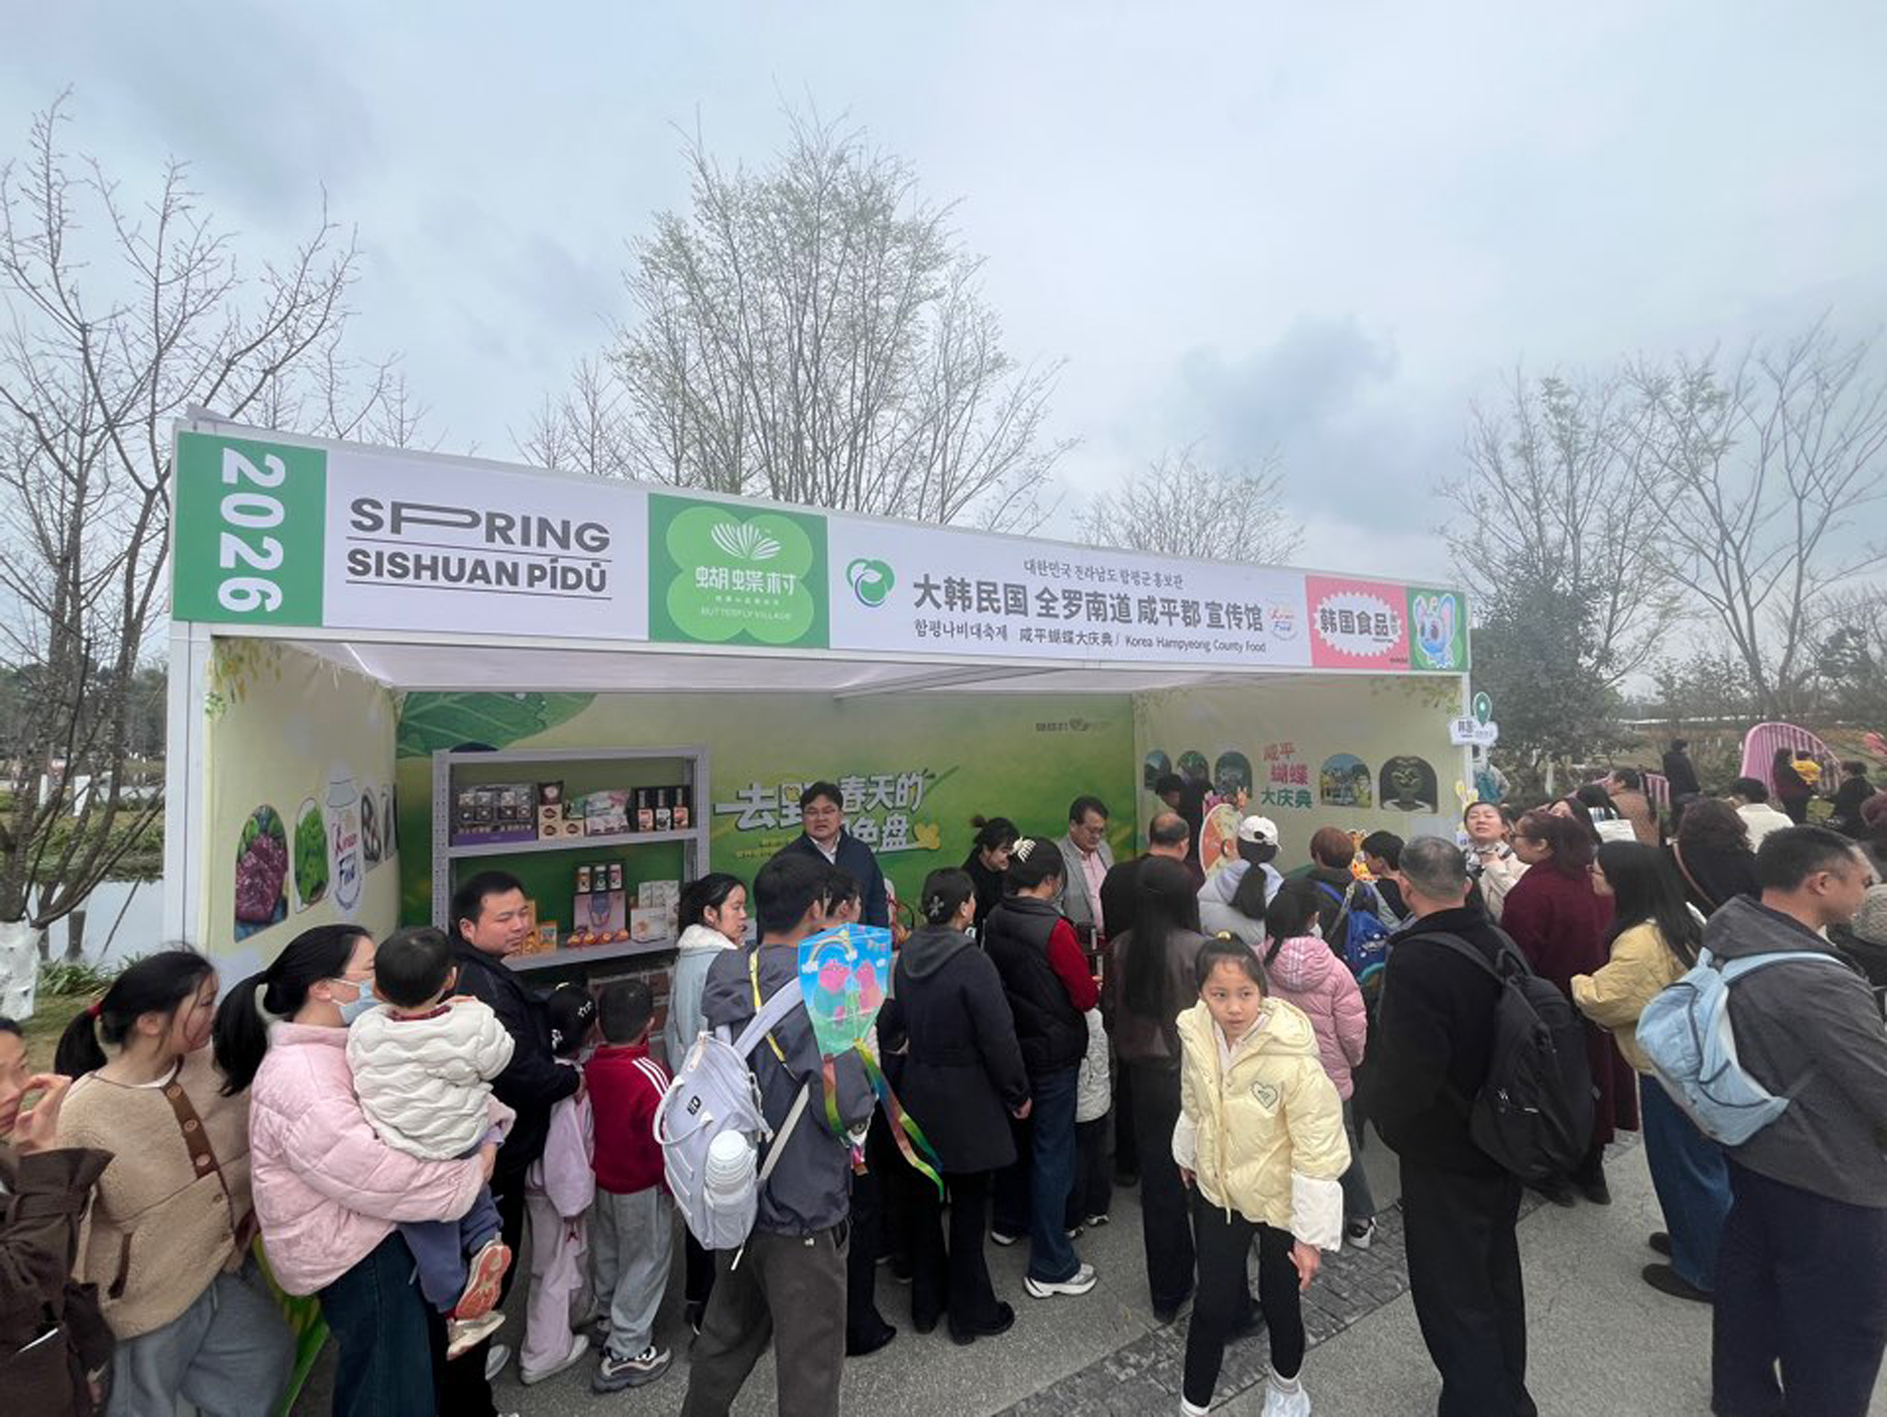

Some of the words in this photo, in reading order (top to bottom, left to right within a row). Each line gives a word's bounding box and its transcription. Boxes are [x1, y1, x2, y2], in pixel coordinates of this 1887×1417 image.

[218, 447, 286, 612] 2026
[350, 498, 610, 553] SPRING
[347, 548, 519, 587] SISHUAN
[695, 565, 797, 597] 蝴蝶村
[1024, 559, 1072, 579] 대한민국
[1074, 565, 1118, 583] 전라남도
[913, 573, 1029, 618] 大韩民国
[1035, 586, 1133, 624] 全罗南道
[1137, 595, 1202, 629] 咸平郡
[1204, 600, 1264, 632] 宣传馆
[914, 618, 1008, 642] 함평나비대축제
[1319, 607, 1389, 637] 韩国食品
[1126, 635, 1153, 648] Korea
[1156, 636, 1210, 654] Hampyeong
[1212, 640, 1243, 654] County
[1246, 641, 1266, 653] Food
[1260, 786, 1313, 809] 大庆典
[842, 813, 910, 853] 色盘
